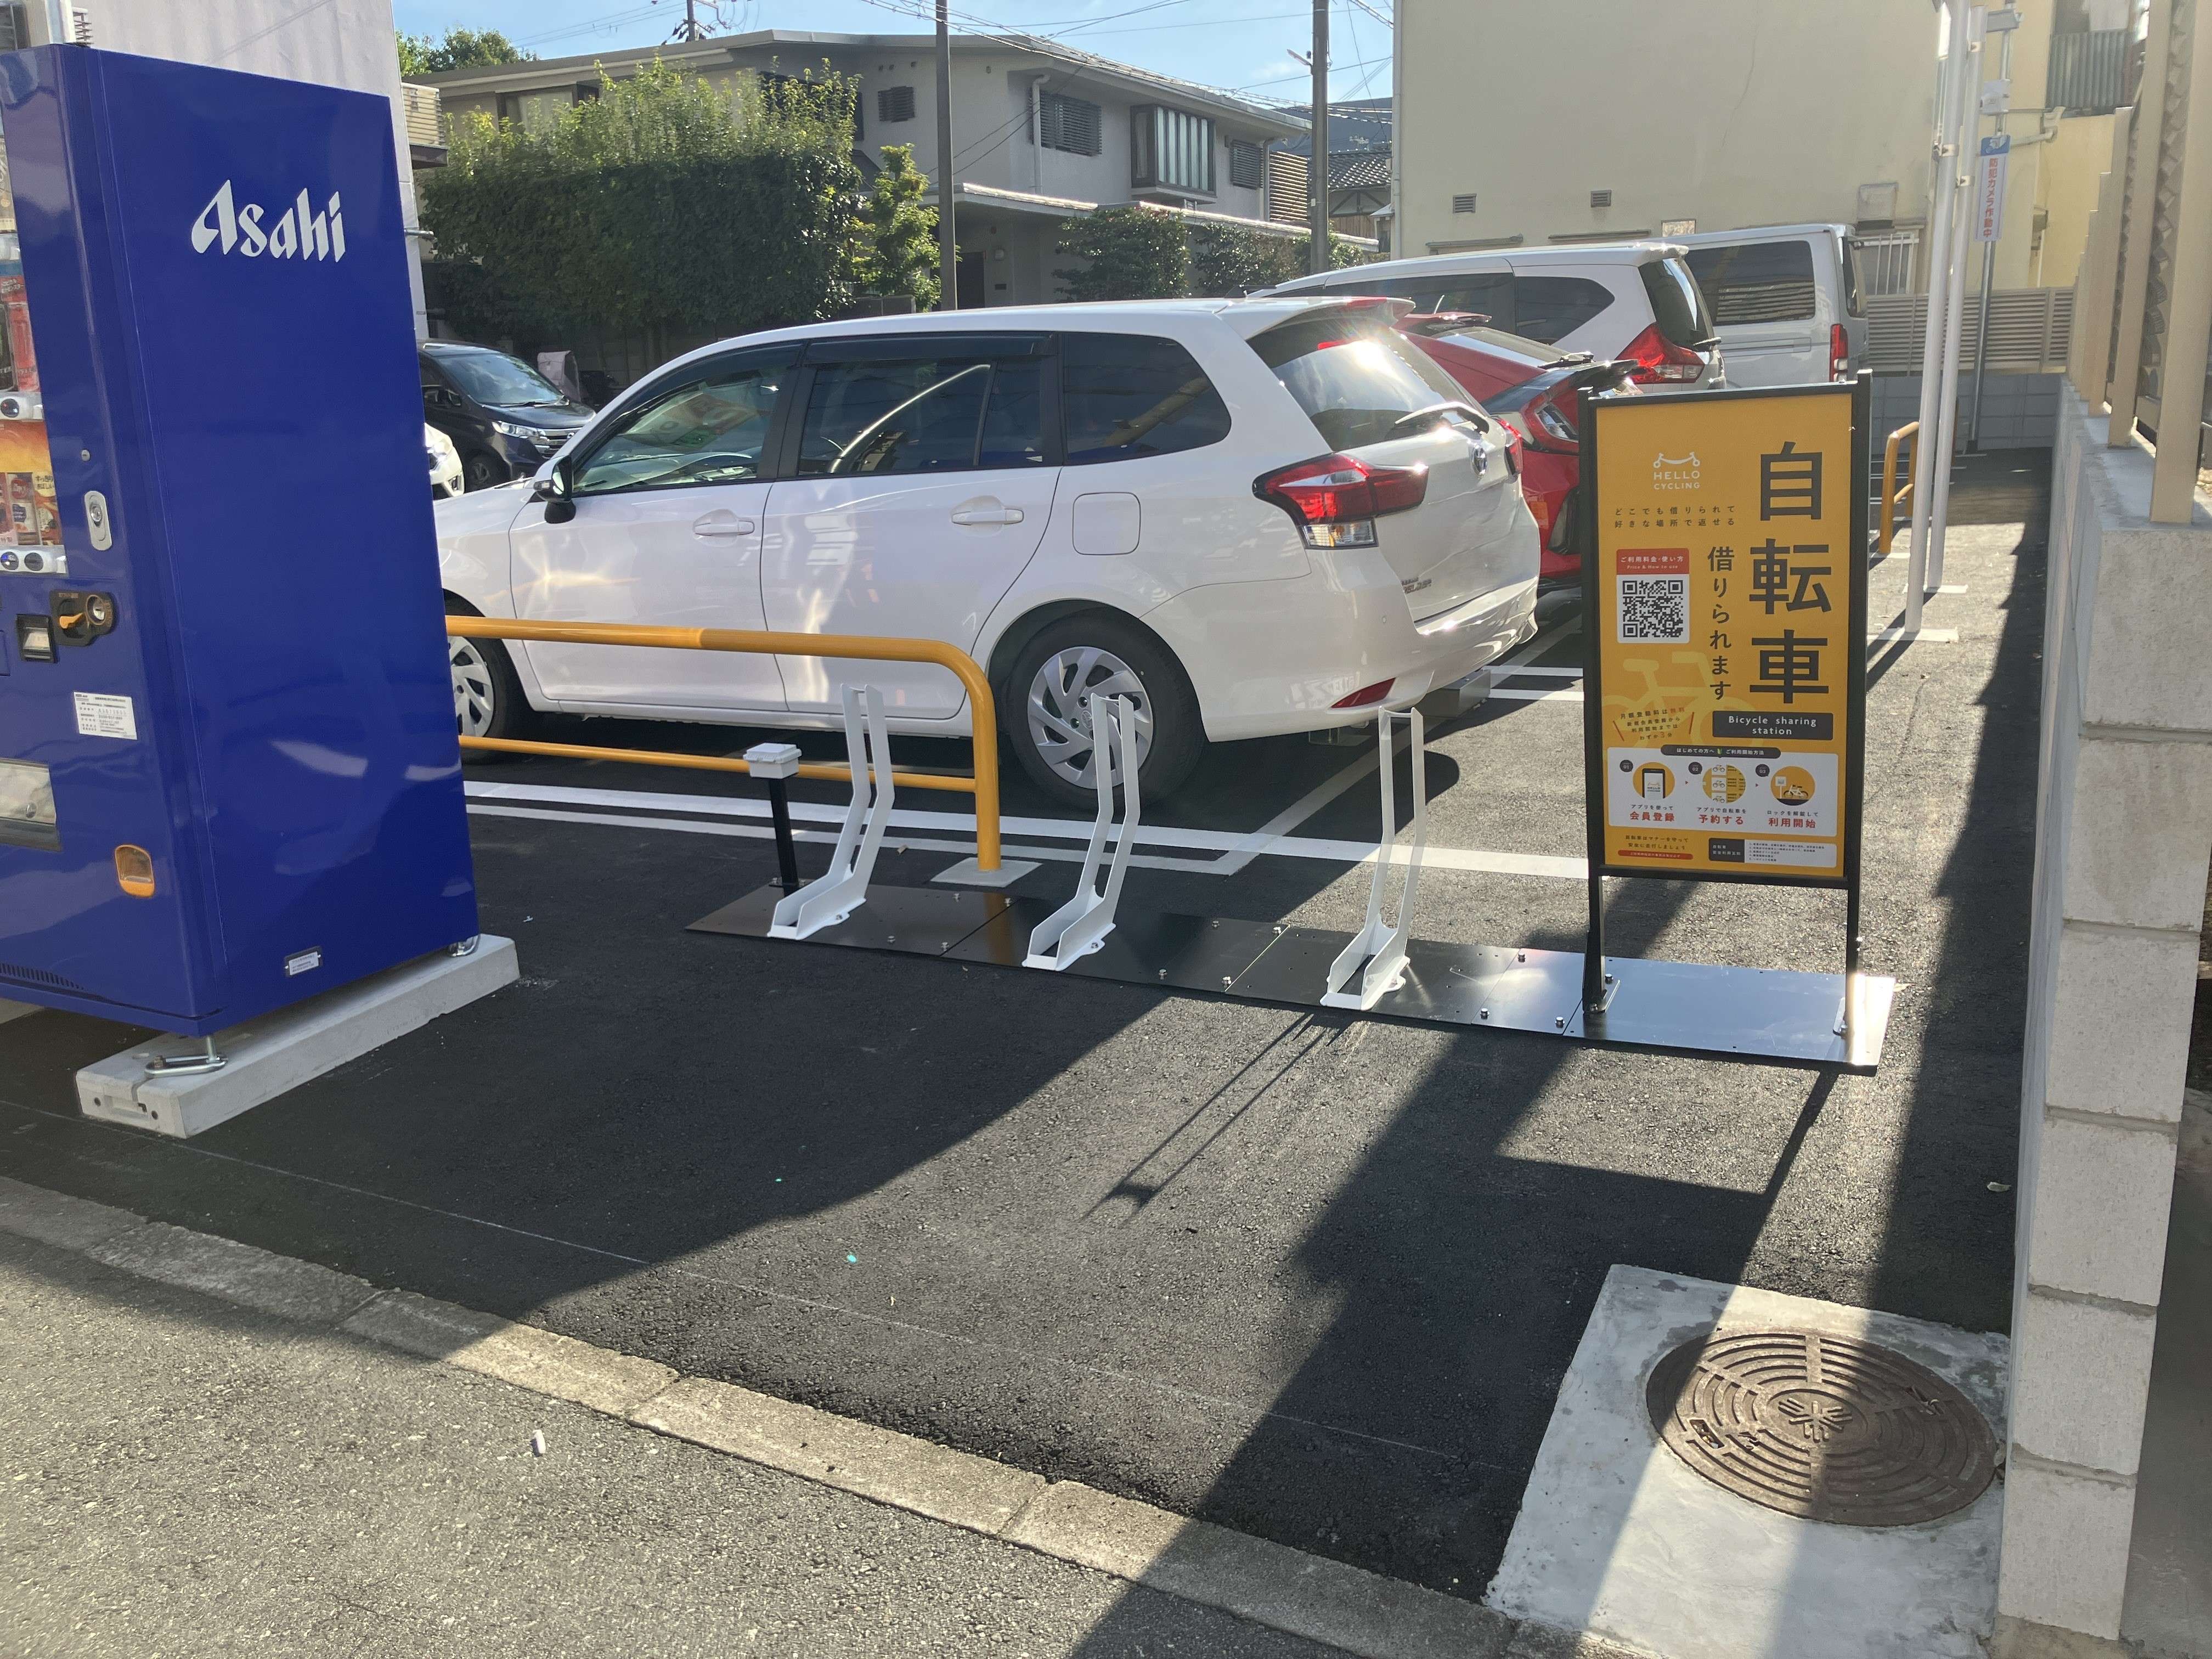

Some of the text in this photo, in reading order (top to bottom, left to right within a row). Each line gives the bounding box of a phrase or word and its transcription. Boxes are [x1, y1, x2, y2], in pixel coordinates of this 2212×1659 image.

[1983, 157, 1998, 237] 防犯カメラ作動中
[191, 179, 346, 262] Asahi
[1654, 470, 1700, 480] HELLO
[1654, 482, 1700, 490] CYCLING
[1615, 505, 1735, 516] どこでも借りられて
[1615, 518, 1734, 528] 好きな場所で返せる
[1749, 441, 1831, 704] 自転車
[1707, 546, 1735, 701] 借りられます
[1729, 716, 1817, 727] Bicycle sharing
[1629, 811, 1674, 822] 会員登録
[1699, 814, 1743, 825] 予約する
[1768, 817, 1816, 828] 利用開始
